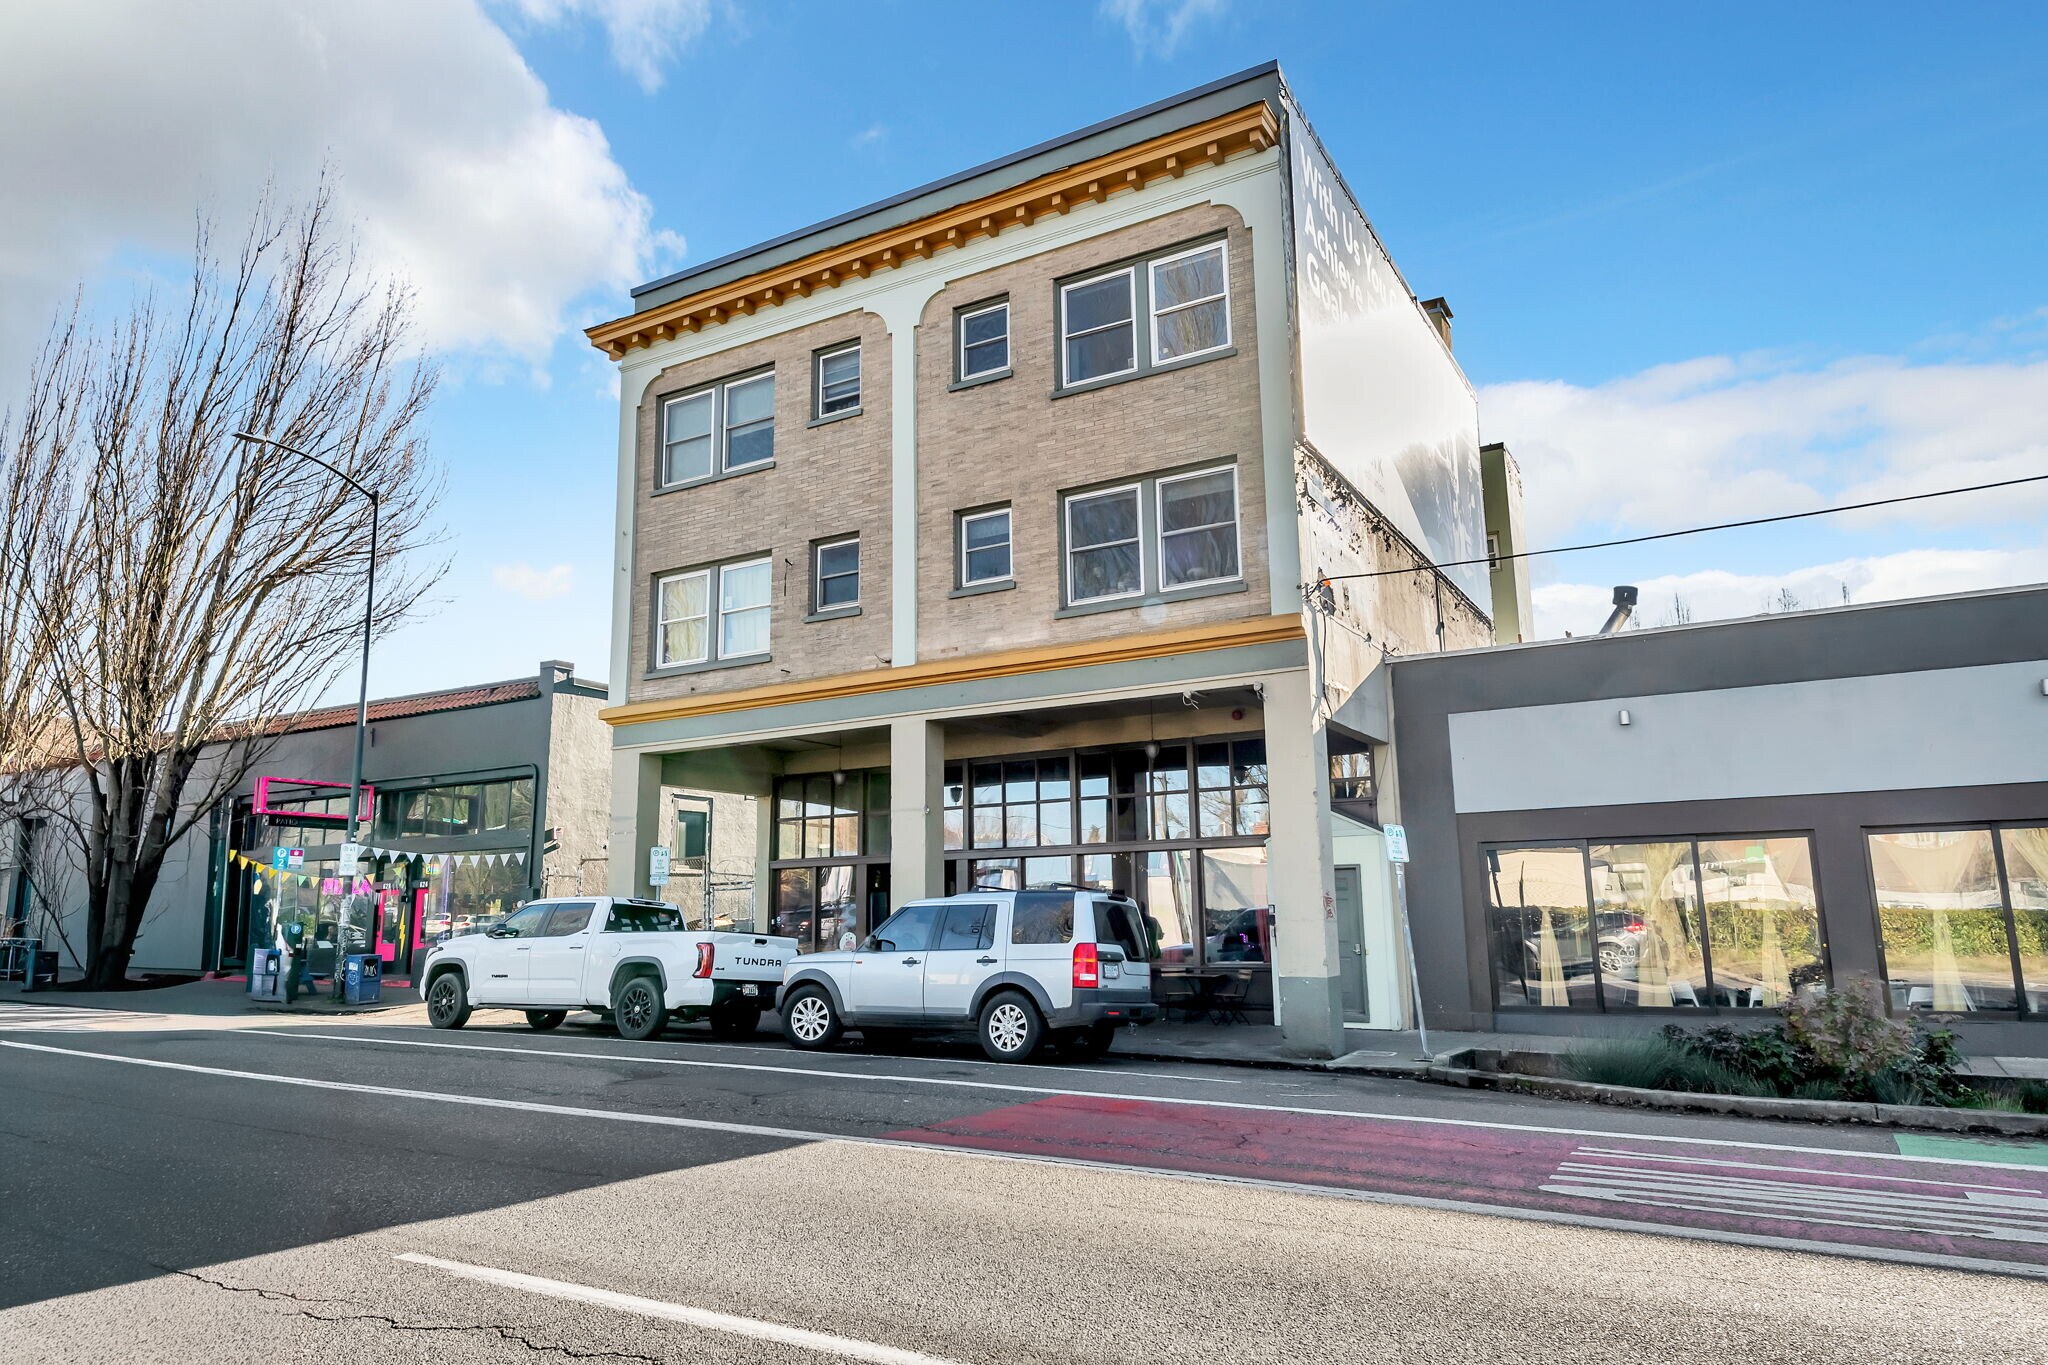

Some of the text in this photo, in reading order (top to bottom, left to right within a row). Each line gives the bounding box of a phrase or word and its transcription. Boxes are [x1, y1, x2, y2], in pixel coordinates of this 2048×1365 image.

[1300, 142, 1339, 234] With
[1342, 210, 1361, 266] Us
[1305, 202, 1363, 312] Achieve
[277, 858, 284, 867] 2
[735, 956, 782, 967] TUNDRA
